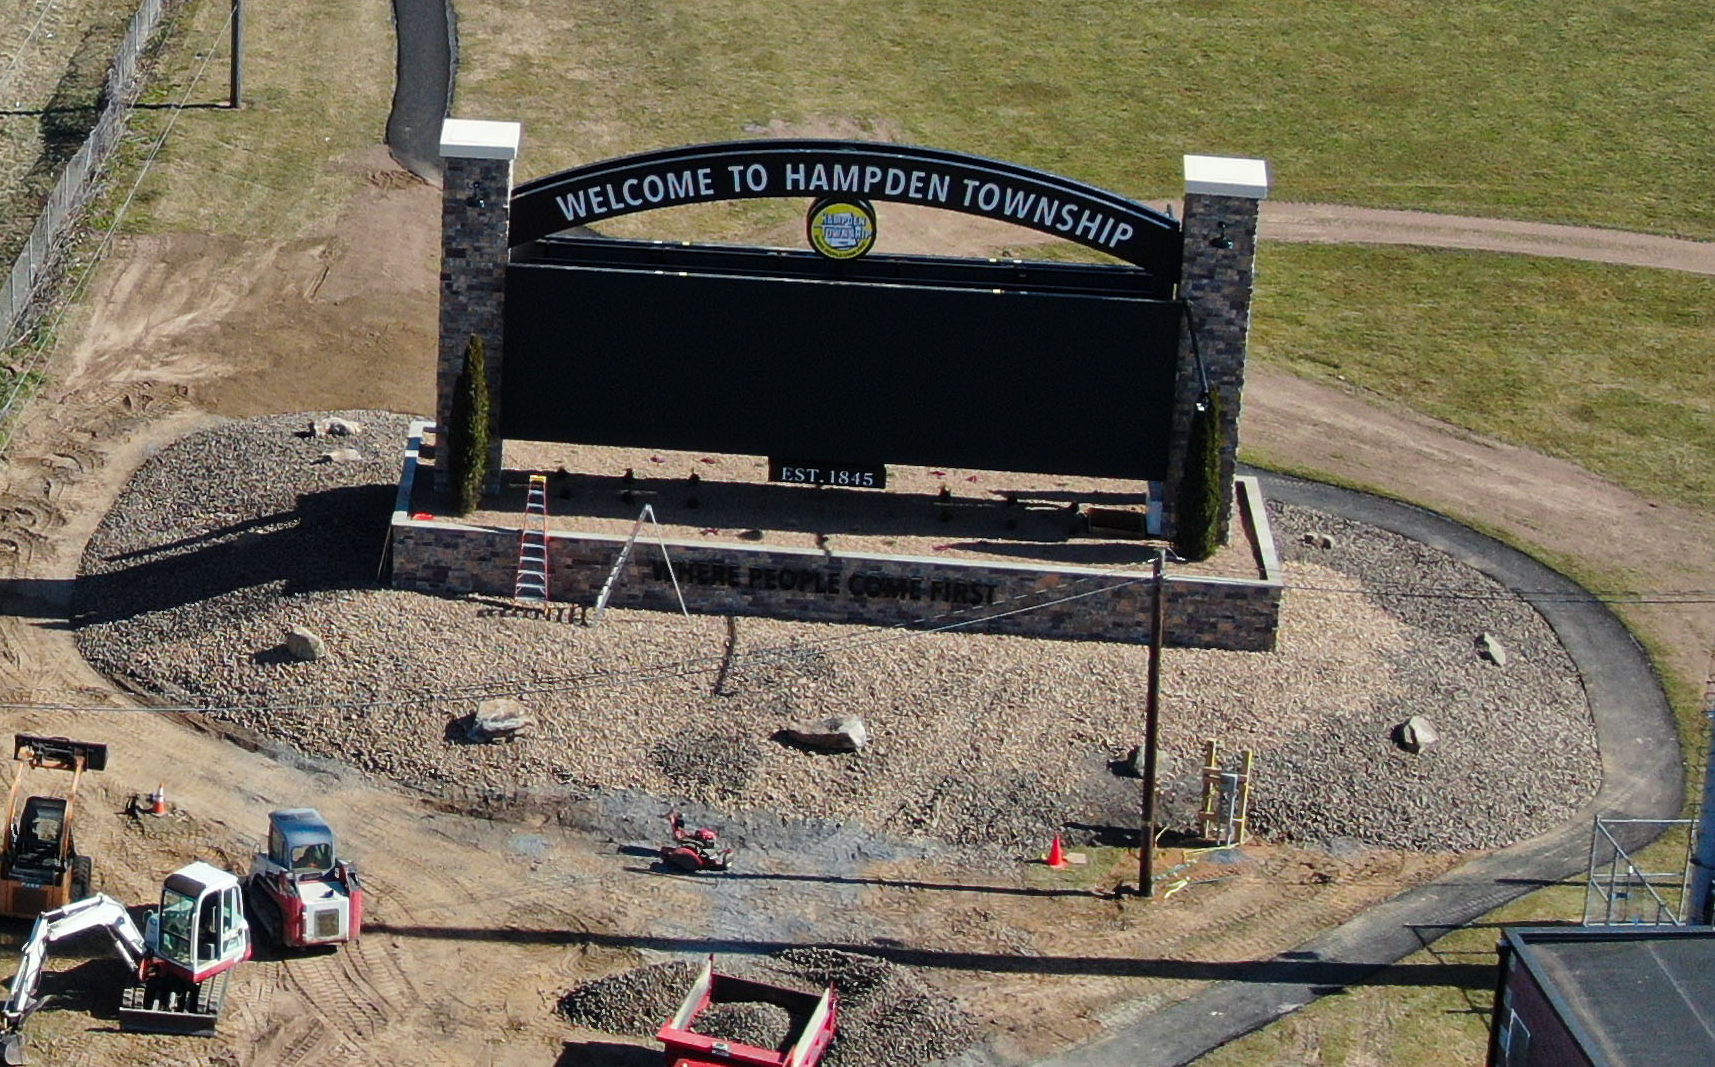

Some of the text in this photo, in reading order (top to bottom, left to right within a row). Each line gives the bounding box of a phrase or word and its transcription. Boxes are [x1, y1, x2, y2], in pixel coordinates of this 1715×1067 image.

[555, 163, 1134, 248] WELCOME TO HAMPDEN TOWNSHIP
[748, 565, 841, 595] PEOPLE
[847, 570, 923, 601] COME
[930, 577, 999, 606] FIRST
